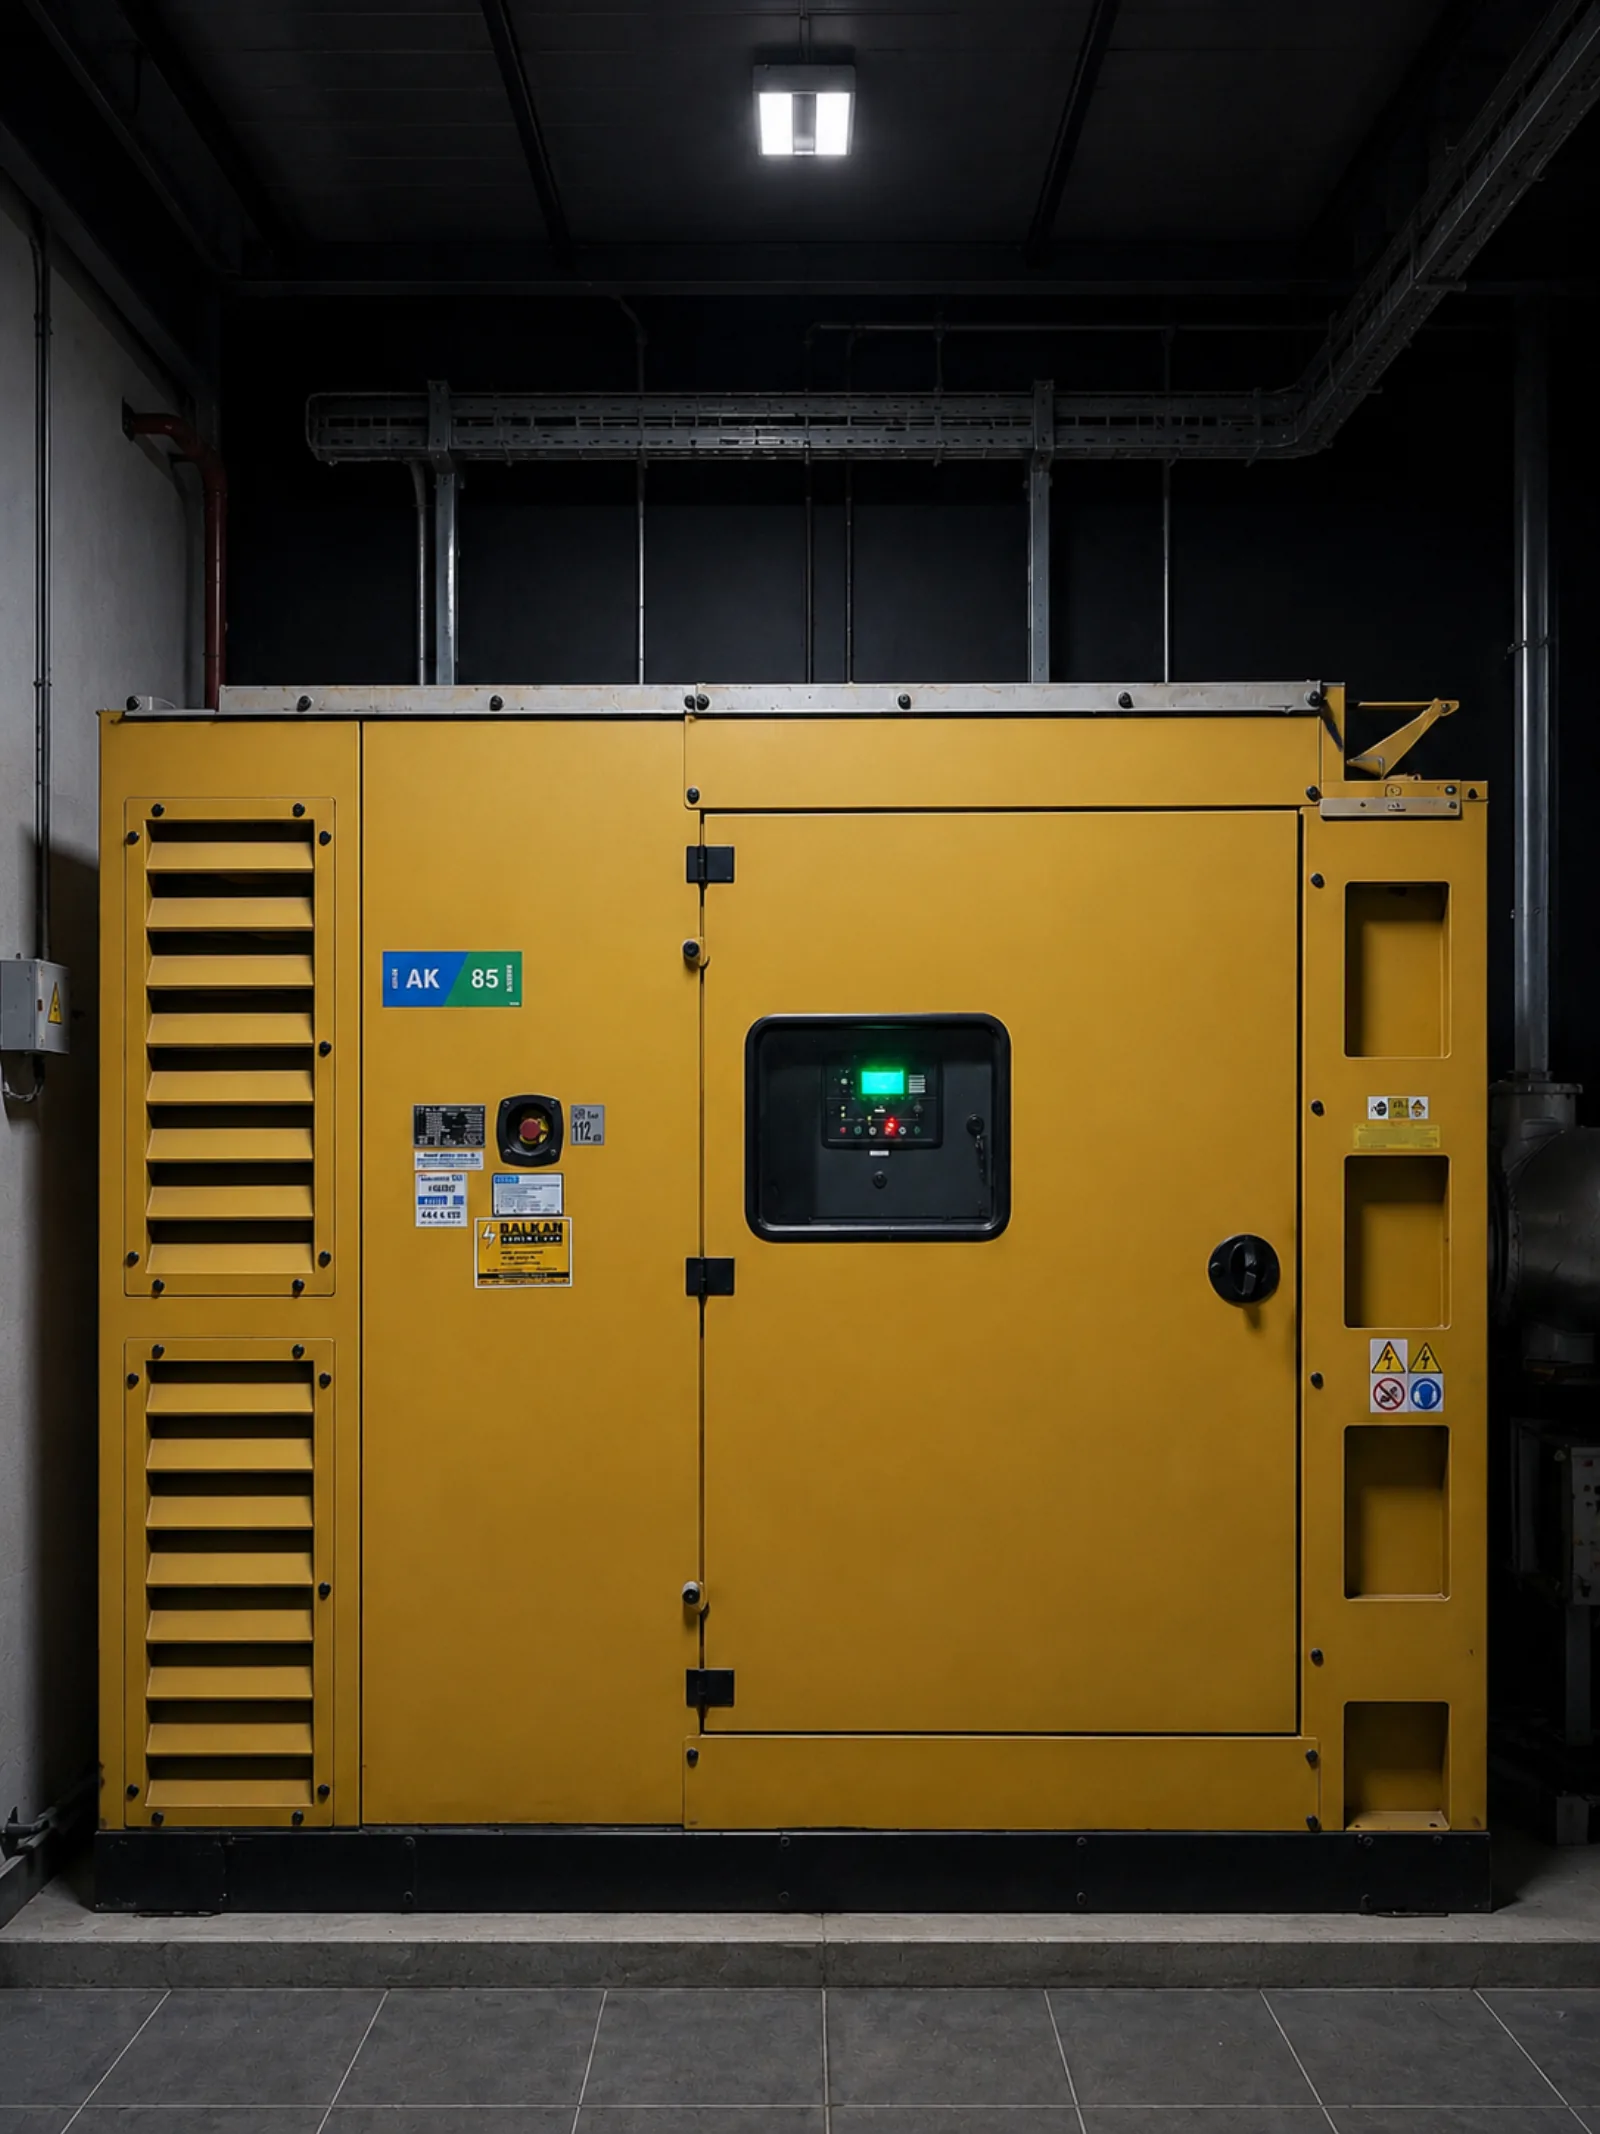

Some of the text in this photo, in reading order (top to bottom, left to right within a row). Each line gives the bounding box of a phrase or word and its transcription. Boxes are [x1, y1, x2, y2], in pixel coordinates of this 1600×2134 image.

[405, 968, 440, 989] AK
[471, 968, 499, 989] 85
[572, 1120, 591, 1141] 112
